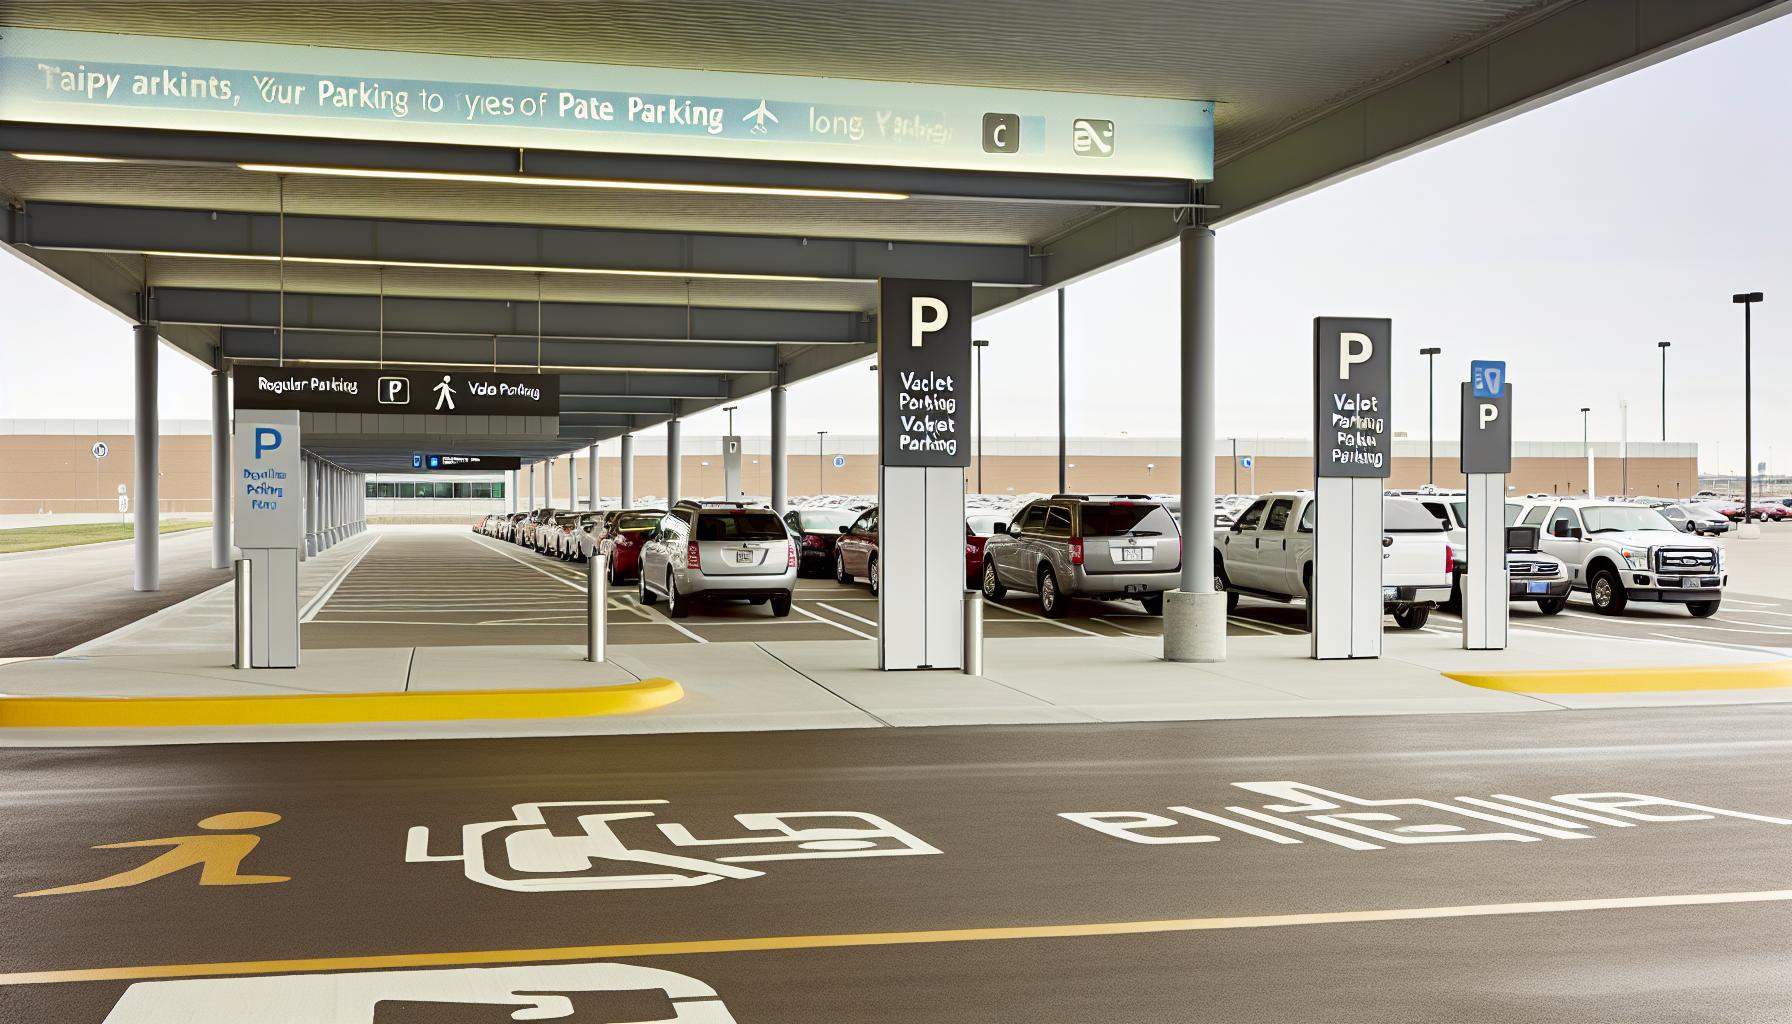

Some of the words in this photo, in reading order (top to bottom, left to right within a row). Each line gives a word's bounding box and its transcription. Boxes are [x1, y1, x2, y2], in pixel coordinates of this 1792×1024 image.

[319, 80, 408, 117] Parking
[419, 89, 443, 112] to
[520, 93, 548, 116] of
[559, 92, 614, 121] Pate
[628, 97, 723, 135] Parking
[809, 107, 864, 141] long
[912, 297, 949, 347] P
[1340, 332, 1373, 380] P
[389, 381, 402, 401] P
[1480, 403, 1499, 430] P
[255, 427, 282, 460] P
